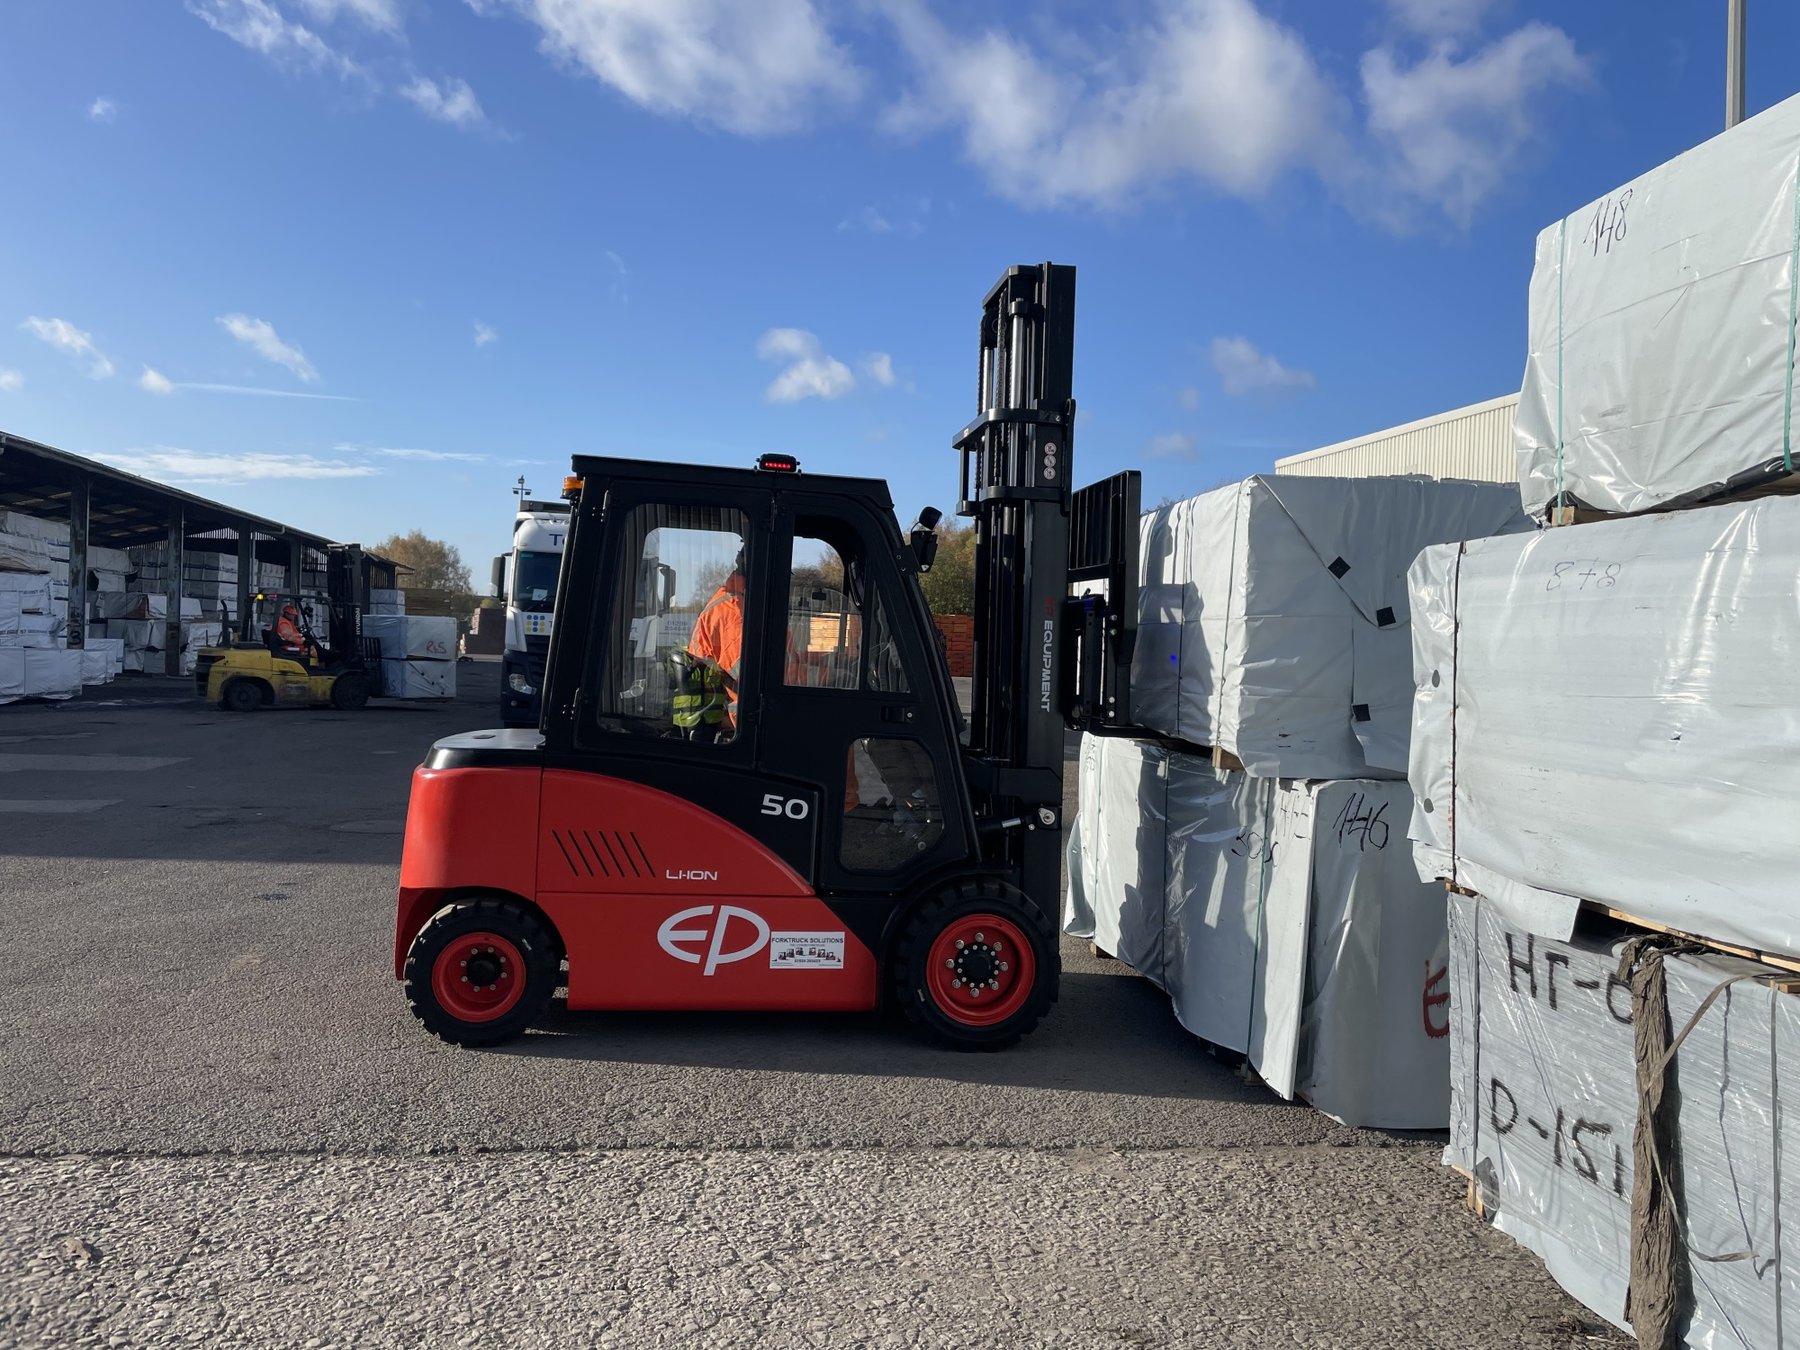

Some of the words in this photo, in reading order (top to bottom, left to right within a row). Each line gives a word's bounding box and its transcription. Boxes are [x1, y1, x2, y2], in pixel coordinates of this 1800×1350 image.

[1583, 188, 1633, 257] 148
[549, 533, 566, 546] T
[1041, 619, 1053, 713] EQUIPMENT
[760, 793, 809, 820] 50
[1332, 792, 1389, 852] 146
[665, 869, 718, 881] LI-ION
[657, 904, 771, 976] EP
